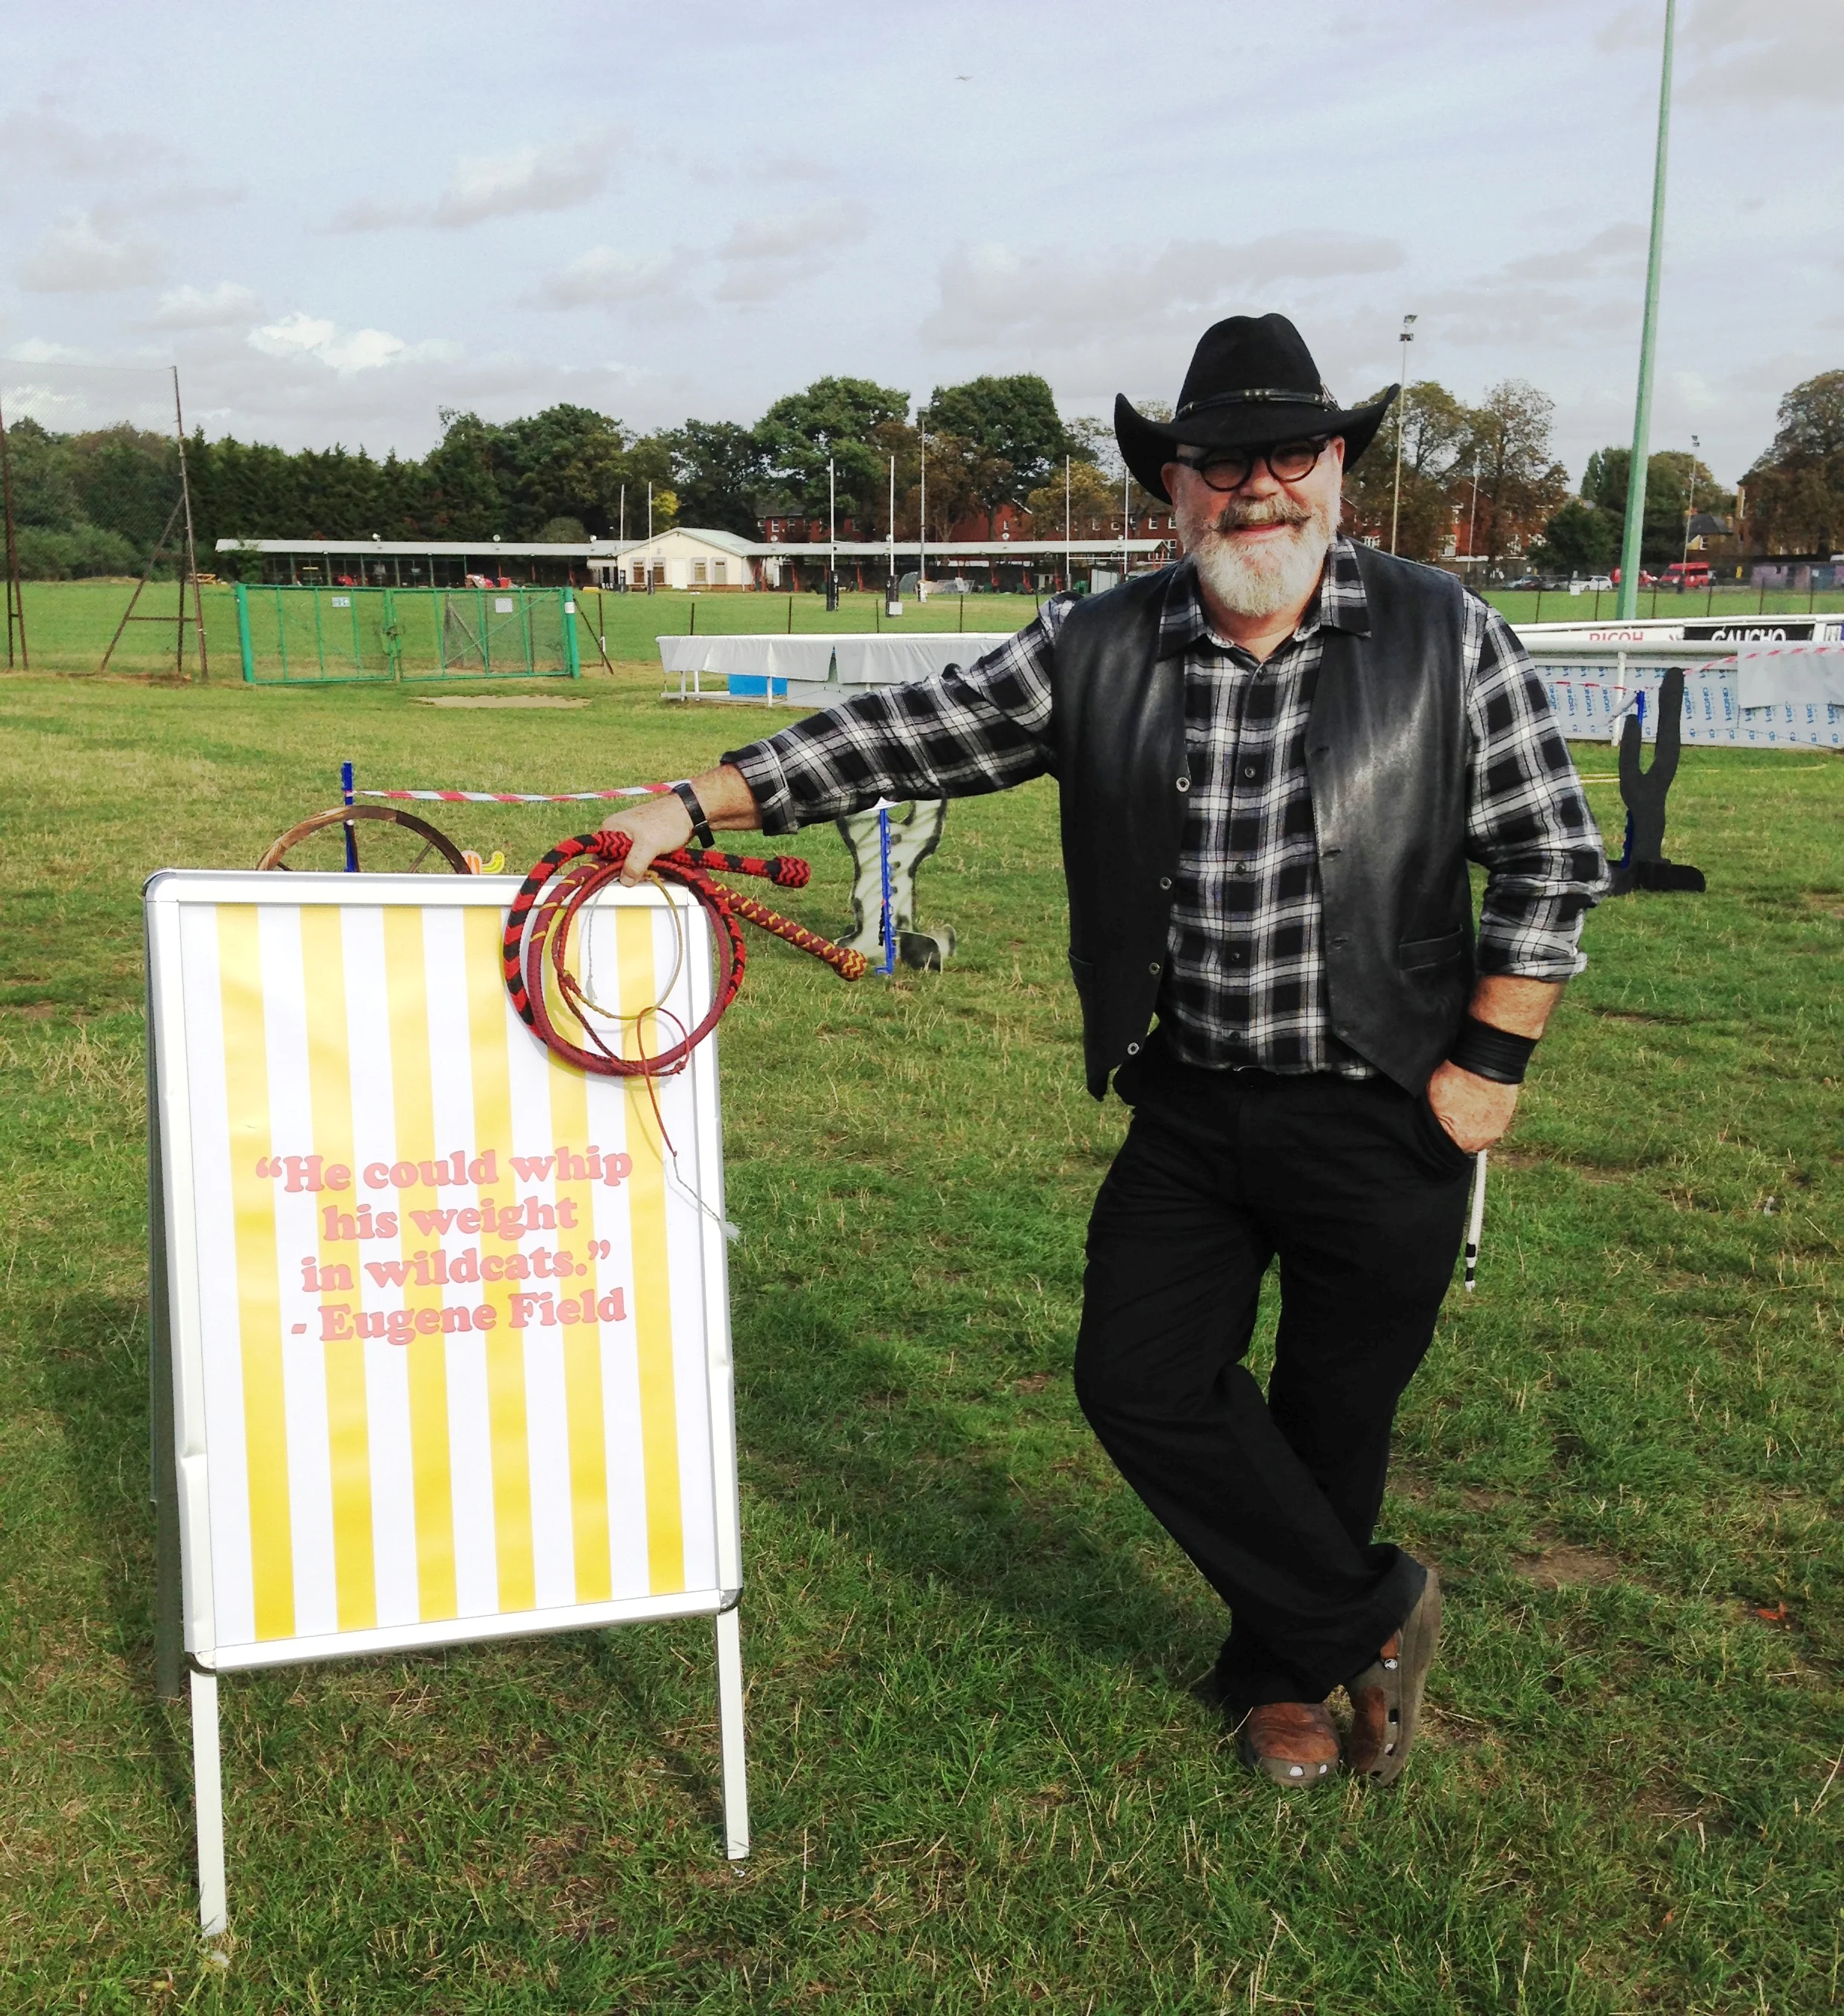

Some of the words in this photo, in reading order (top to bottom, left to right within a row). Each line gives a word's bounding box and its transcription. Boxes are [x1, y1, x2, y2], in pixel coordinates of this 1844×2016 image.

[255, 1155, 352, 1193] “He
[362, 1150, 499, 1189] could
[508, 1145, 633, 1187] whip
[322, 1204, 398, 1242] his
[408, 1196, 579, 1242] weight
[301, 1256, 354, 1293] in
[364, 1239, 612, 1288] wildcats.”
[318, 1303, 498, 1346] Eugene
[508, 1287, 627, 1330] Field
